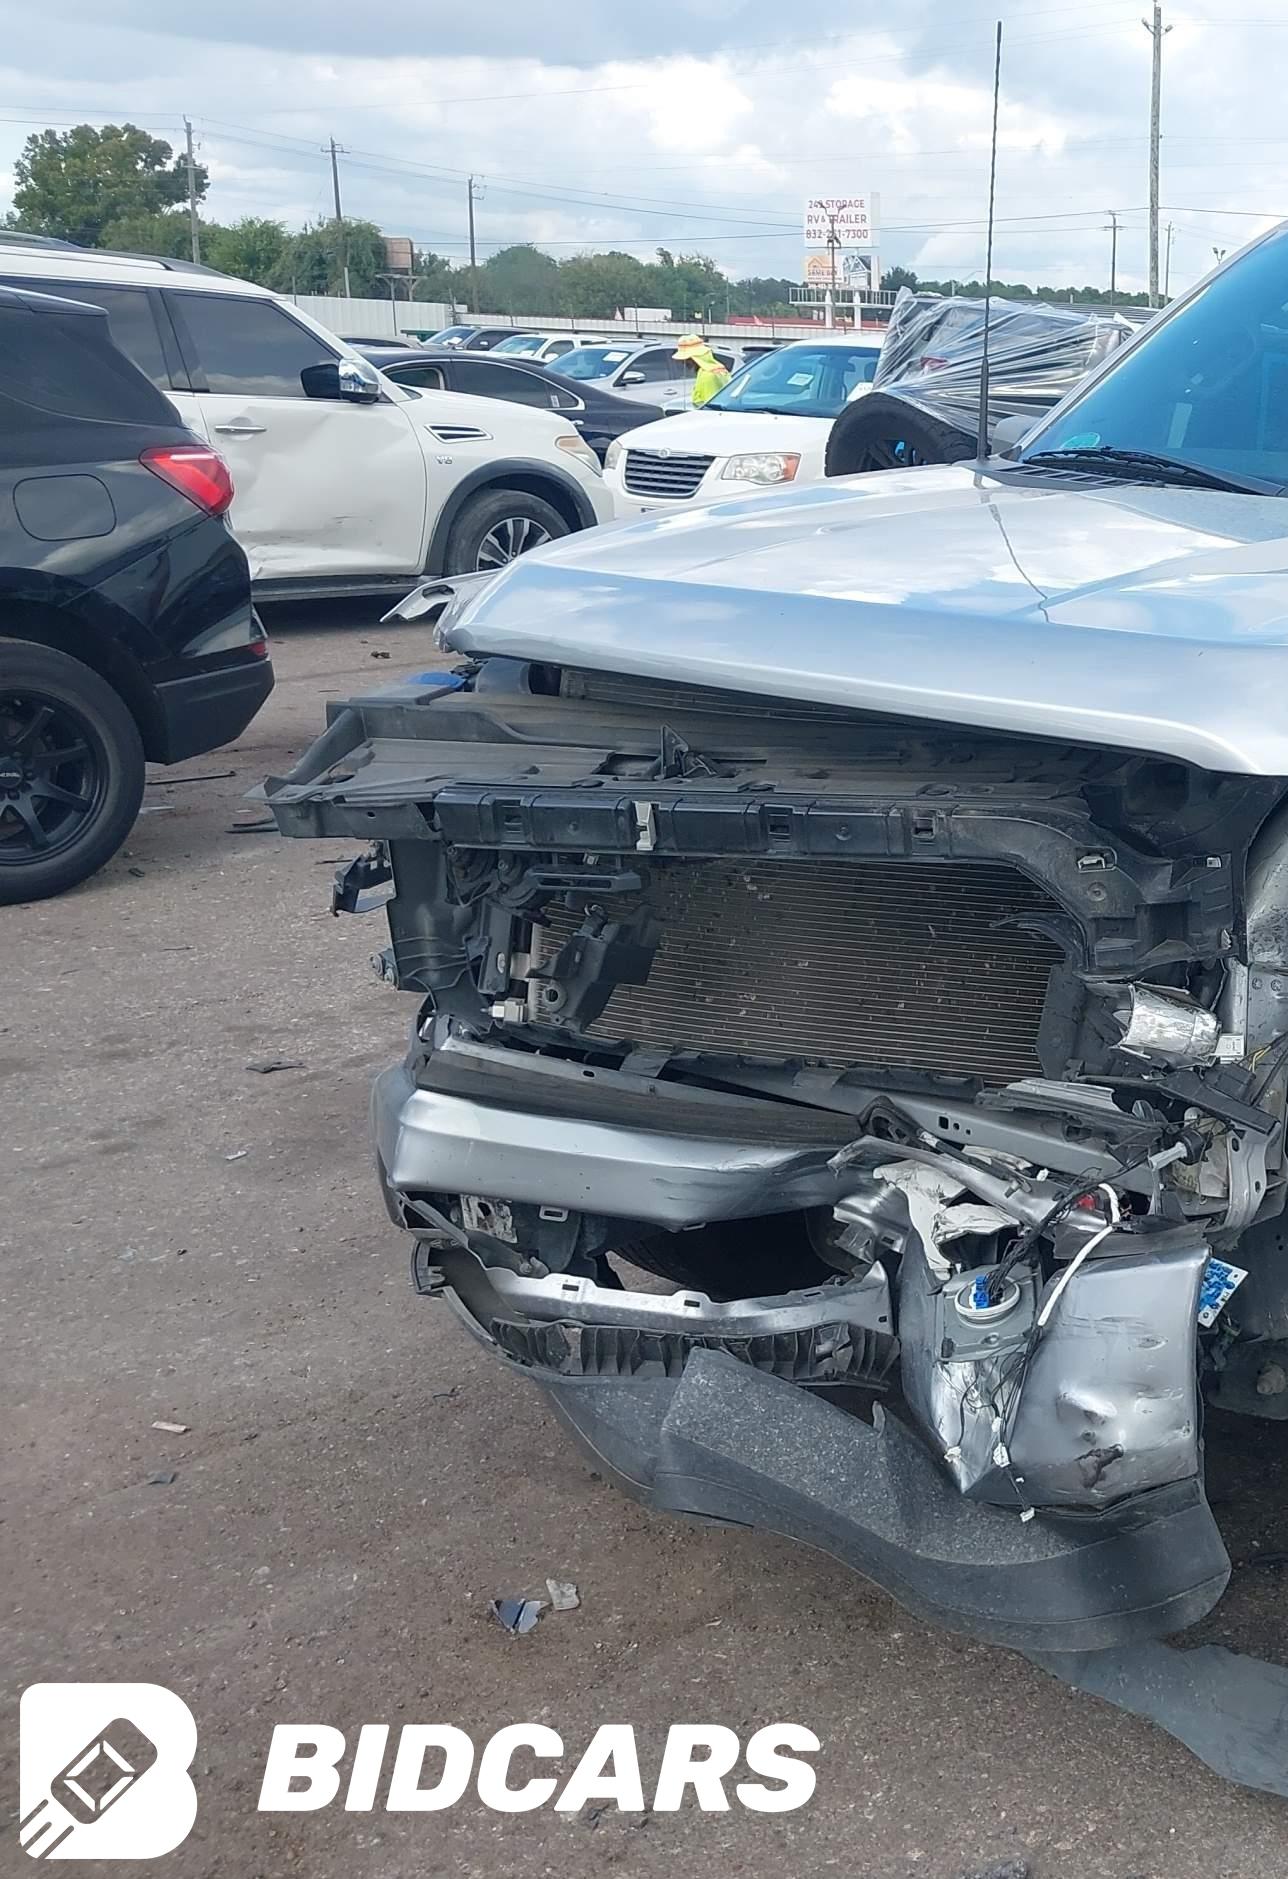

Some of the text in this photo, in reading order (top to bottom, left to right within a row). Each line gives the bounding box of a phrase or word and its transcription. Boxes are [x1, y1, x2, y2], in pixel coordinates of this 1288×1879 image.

[825, 199, 865, 209] STORAGE
[807, 214, 820, 224] RV
[828, 214, 868, 224] TRAILER
